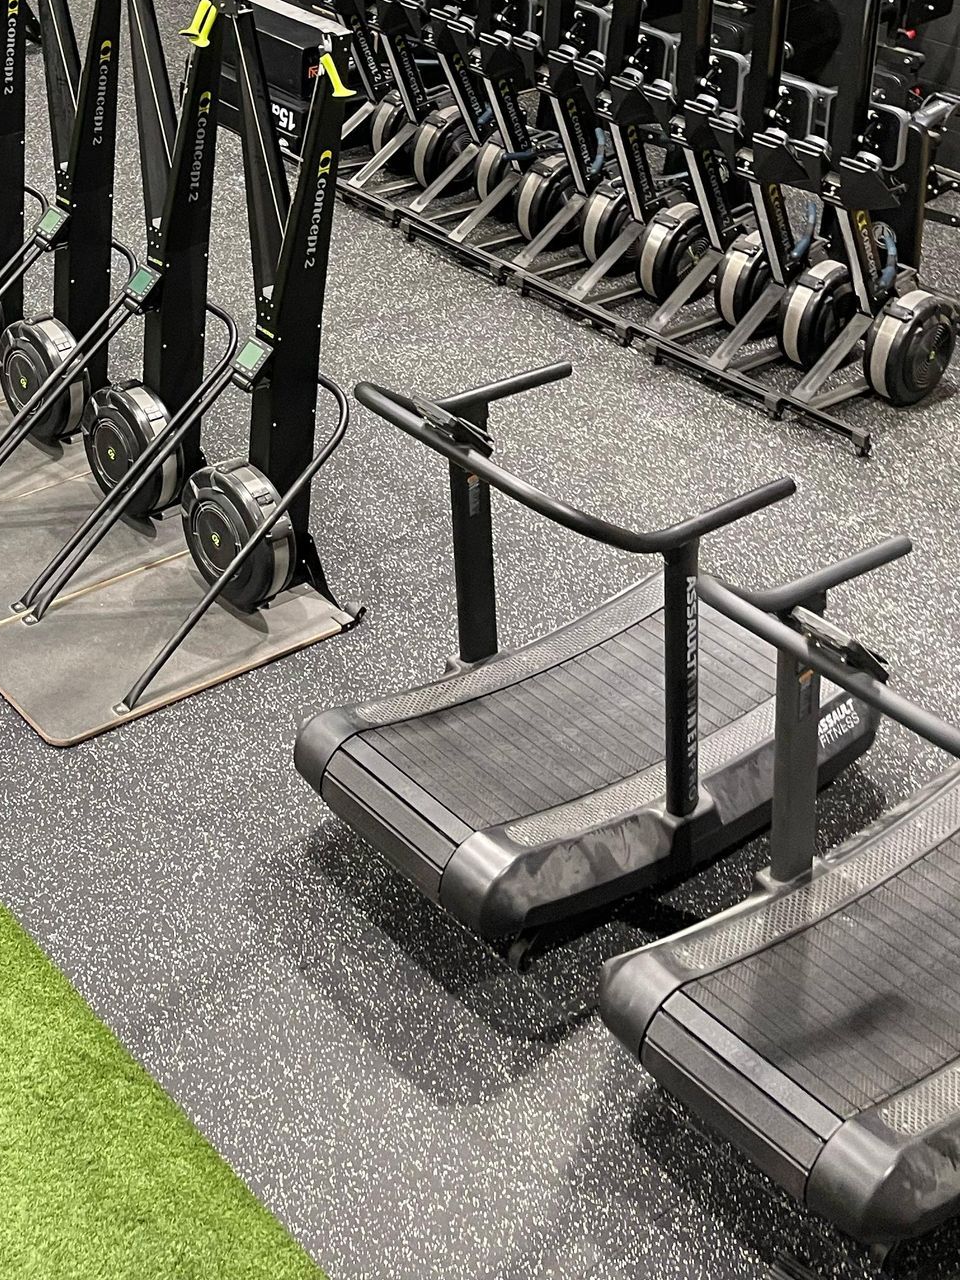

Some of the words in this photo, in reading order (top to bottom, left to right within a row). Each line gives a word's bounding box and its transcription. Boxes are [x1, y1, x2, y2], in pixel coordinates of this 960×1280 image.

[4, 18, 17, 84] concept
[94, 65, 109, 134] concept
[190, 117, 207, 192] concept
[306, 178, 327, 256] concept
[819, 711, 860, 749] FITNESS
